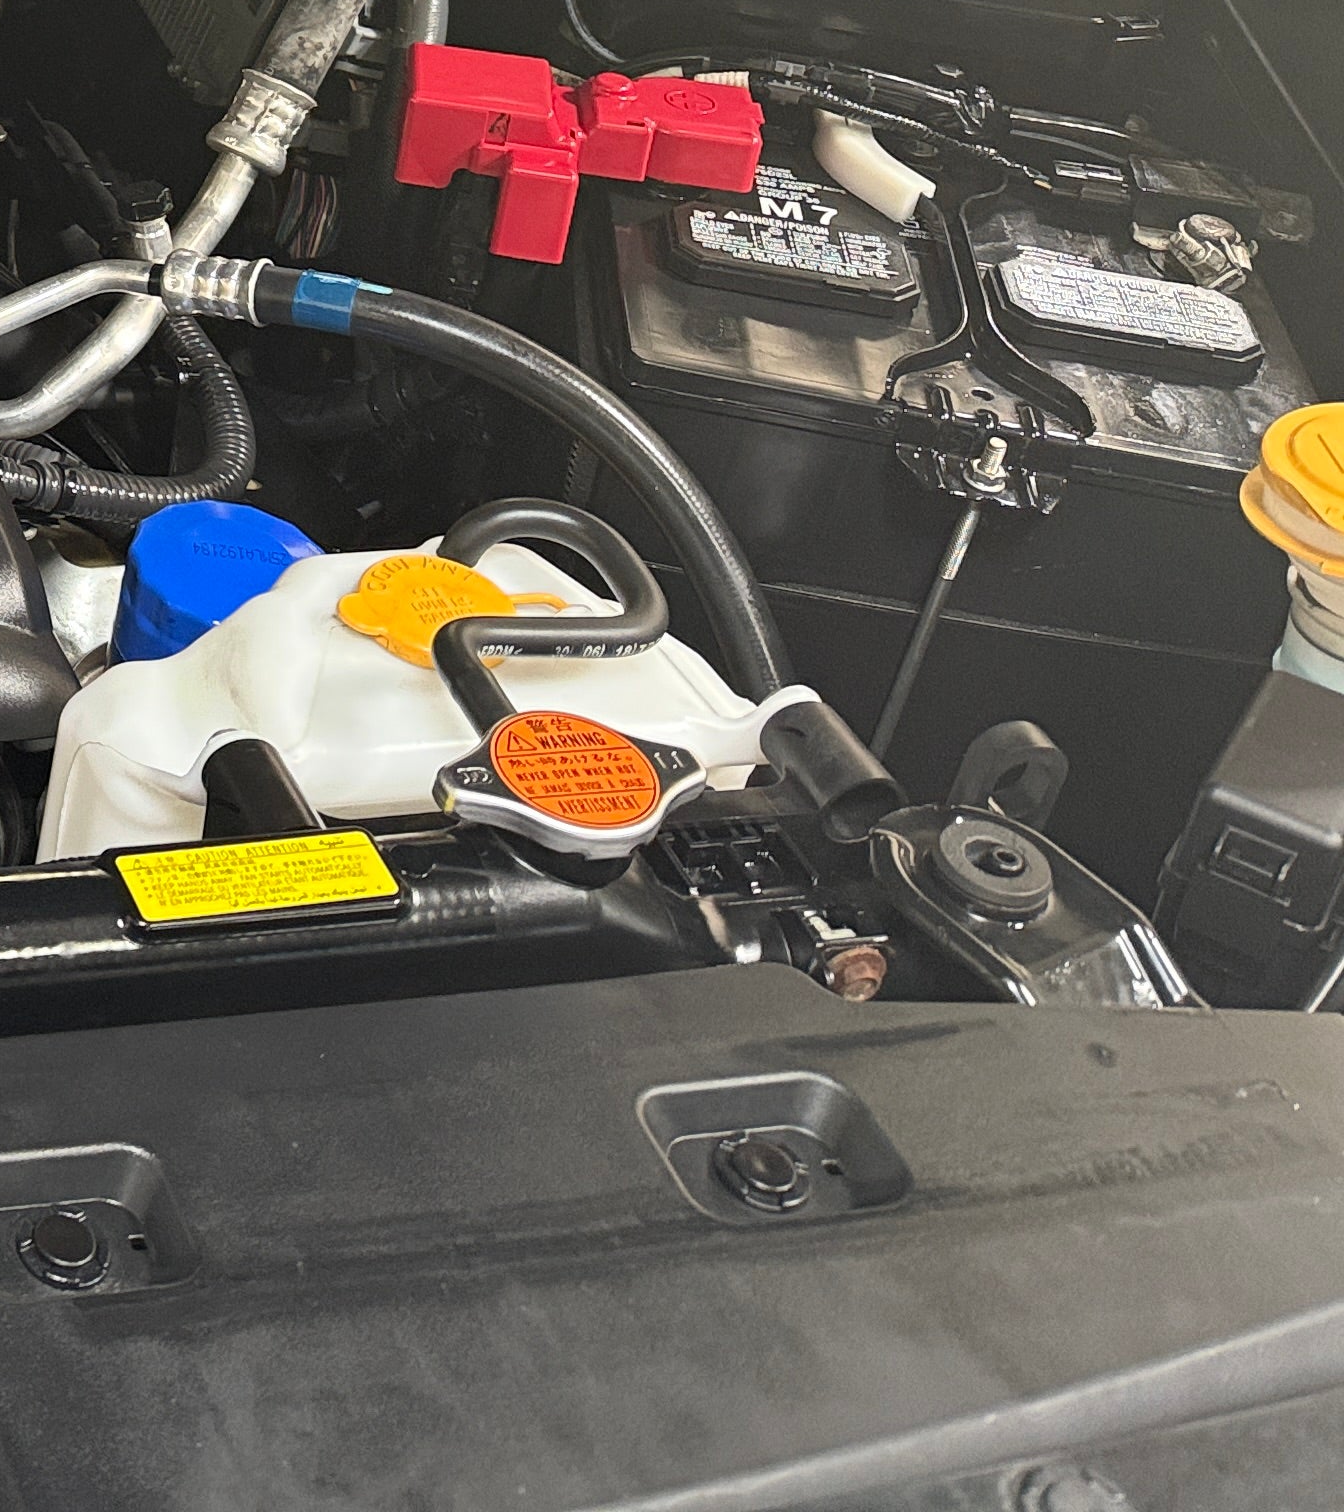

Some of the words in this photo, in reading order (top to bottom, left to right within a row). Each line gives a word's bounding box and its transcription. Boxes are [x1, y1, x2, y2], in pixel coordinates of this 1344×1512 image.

[534, 731, 607, 750] WARNING
[515, 770, 550, 782] NEVER
[552, 768, 581, 779] OPEN
[582, 765, 614, 777] WHEN
[558, 794, 643, 817] AVERTISSMENT
[186, 849, 238, 863] CAUTION
[245, 841, 310, 857] ATTENTION
